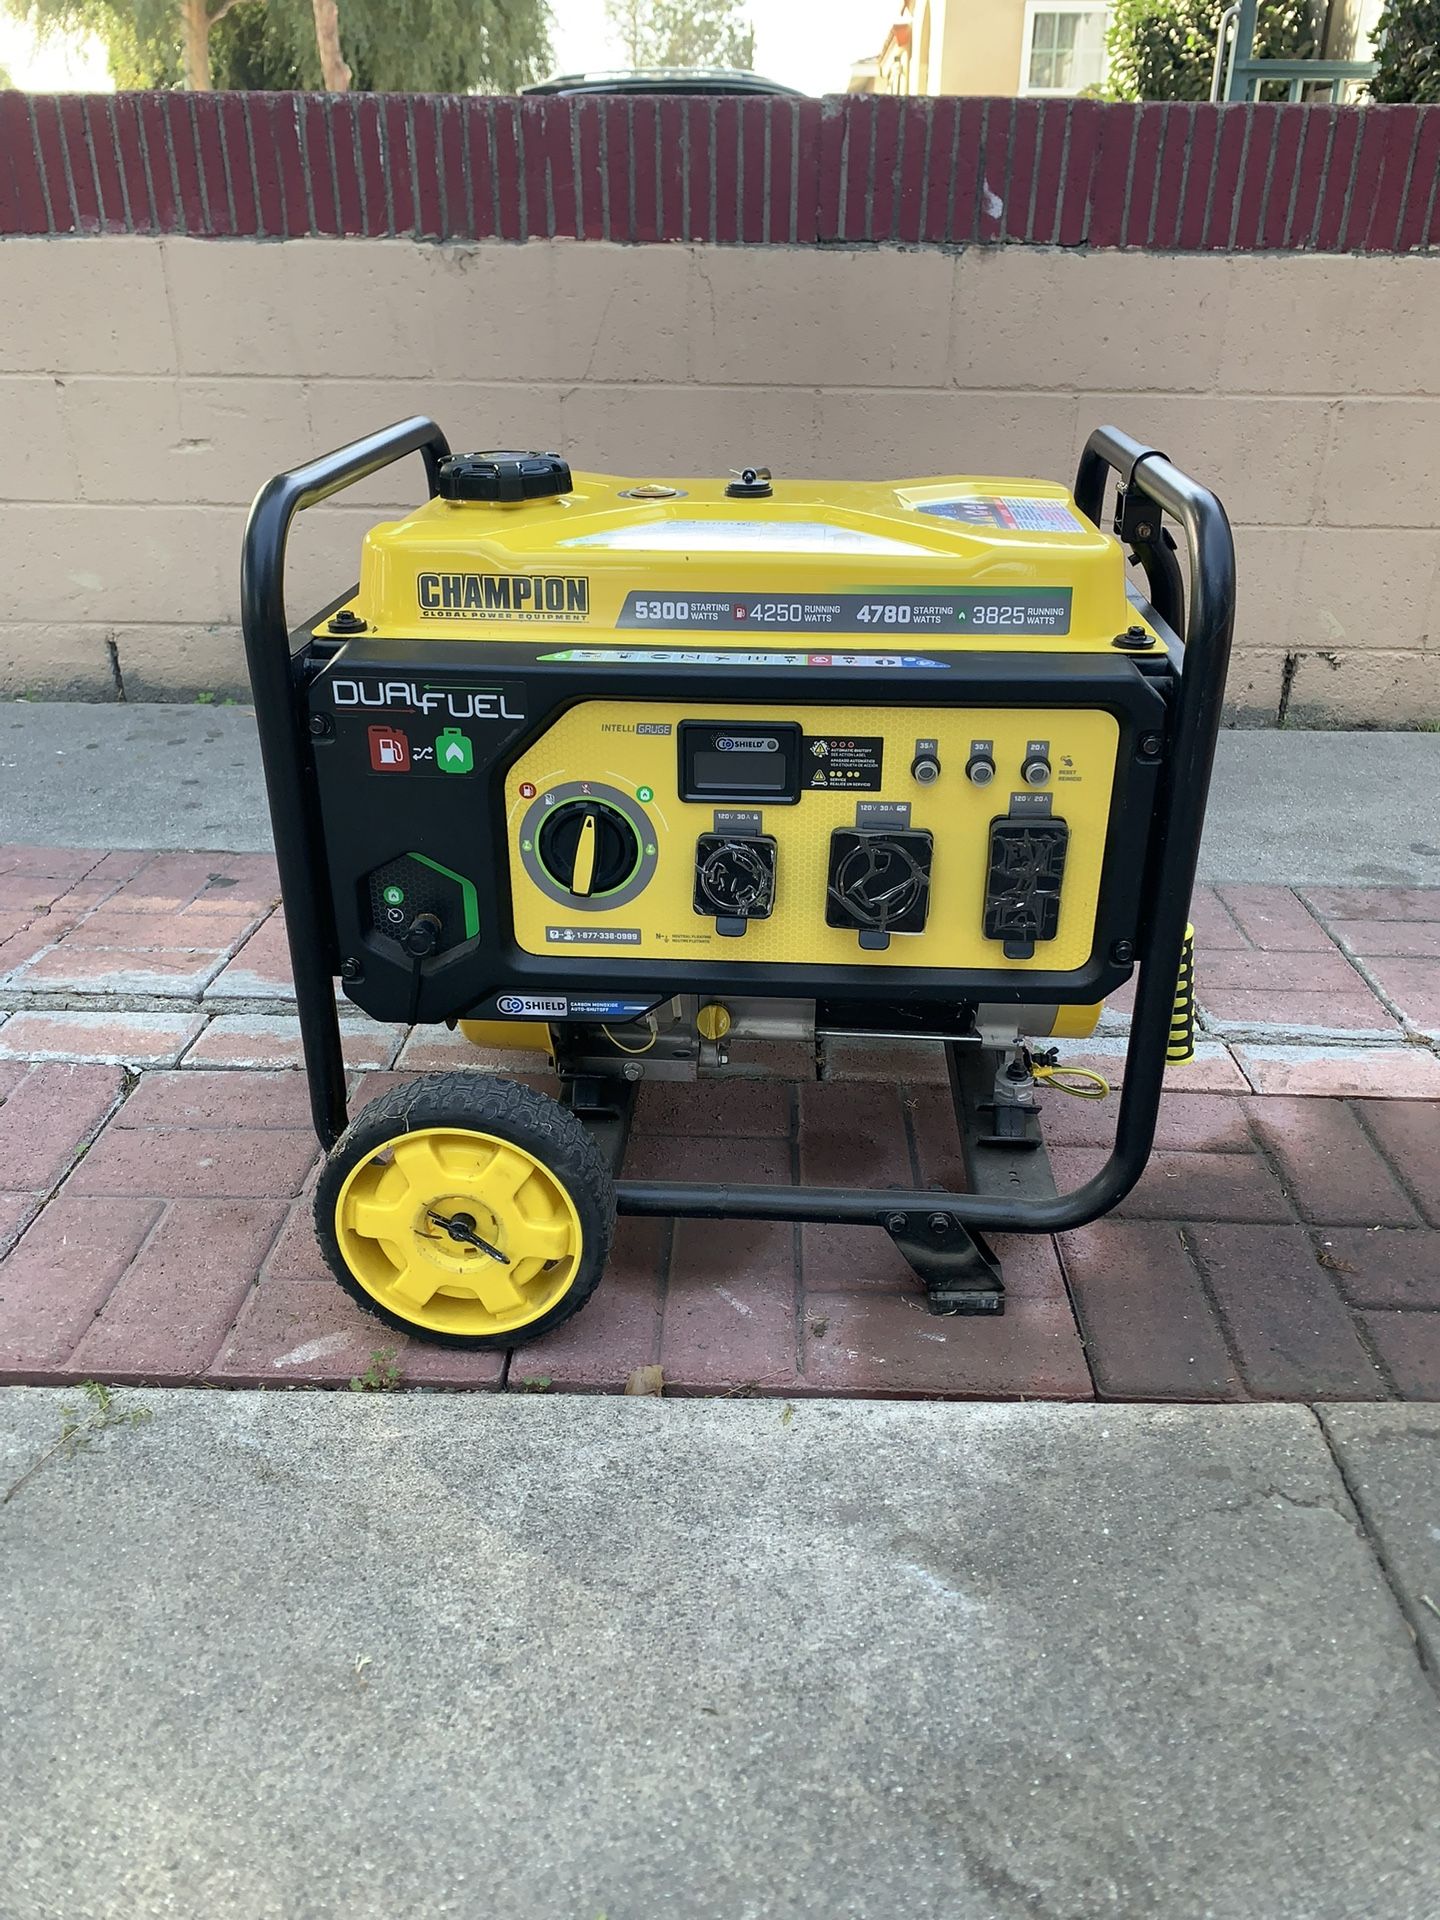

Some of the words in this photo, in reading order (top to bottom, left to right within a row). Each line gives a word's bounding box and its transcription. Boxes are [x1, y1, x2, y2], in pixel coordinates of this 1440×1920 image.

[419, 573, 588, 613] CHAMPION
[635, 601, 689, 620] 5300
[691, 603, 730, 612] STARTING
[804, 605, 841, 614] RUNNING
[913, 606, 953, 615] STARTING
[1027, 607, 1064, 616] RUNNING
[518, 613, 588, 621] EQUIPMENT
[691, 612, 719, 620] WATTS
[750, 603, 802, 622] 4250
[856, 605, 911, 623] 4780
[972, 606, 1025, 624] 3825
[804, 614, 832, 623] WATTS
[913, 615, 941, 624] WATTS
[1027, 616, 1055, 625] WATTS
[734, 739, 763, 748] SHIELD
[525, 1001, 565, 1011] SHIELD
